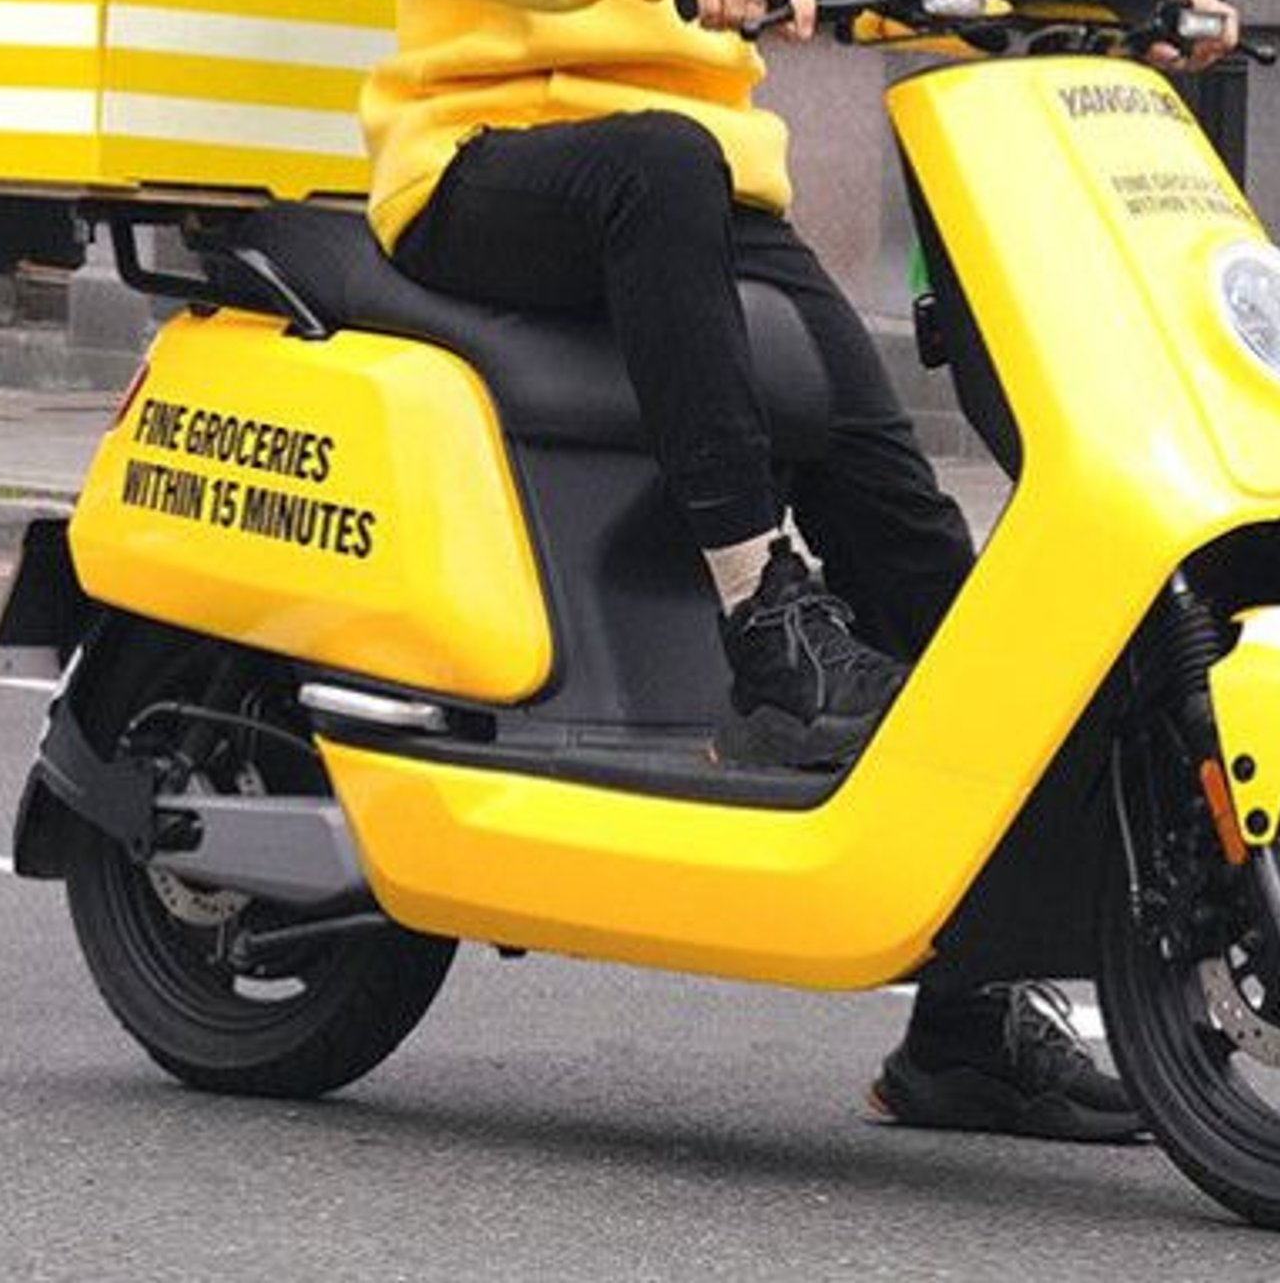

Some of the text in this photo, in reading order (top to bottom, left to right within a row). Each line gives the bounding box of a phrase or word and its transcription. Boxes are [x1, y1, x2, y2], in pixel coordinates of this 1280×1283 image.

[136, 399, 334, 483] FINE GROCERIES
[123, 460, 376, 559] WITHIN 15 MINUTES
